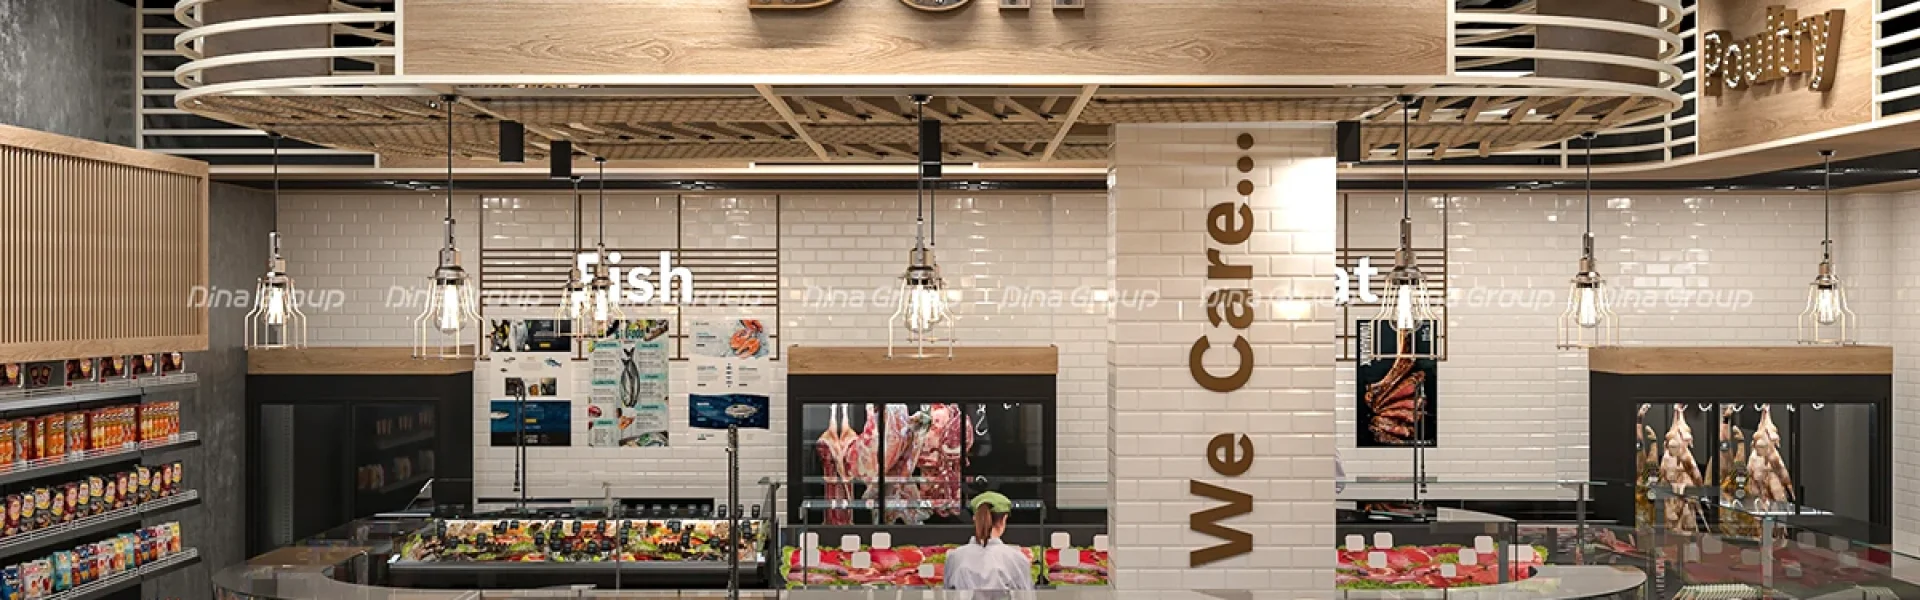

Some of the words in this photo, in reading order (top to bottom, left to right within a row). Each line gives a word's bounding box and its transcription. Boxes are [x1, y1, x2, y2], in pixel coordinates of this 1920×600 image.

[1704, 5, 1845, 96] Poultry
[577, 250, 693, 304] Fish
[1189, 132, 1254, 393] Care...
[1336, 256, 1379, 304] at
[1189, 432, 1254, 569] We
